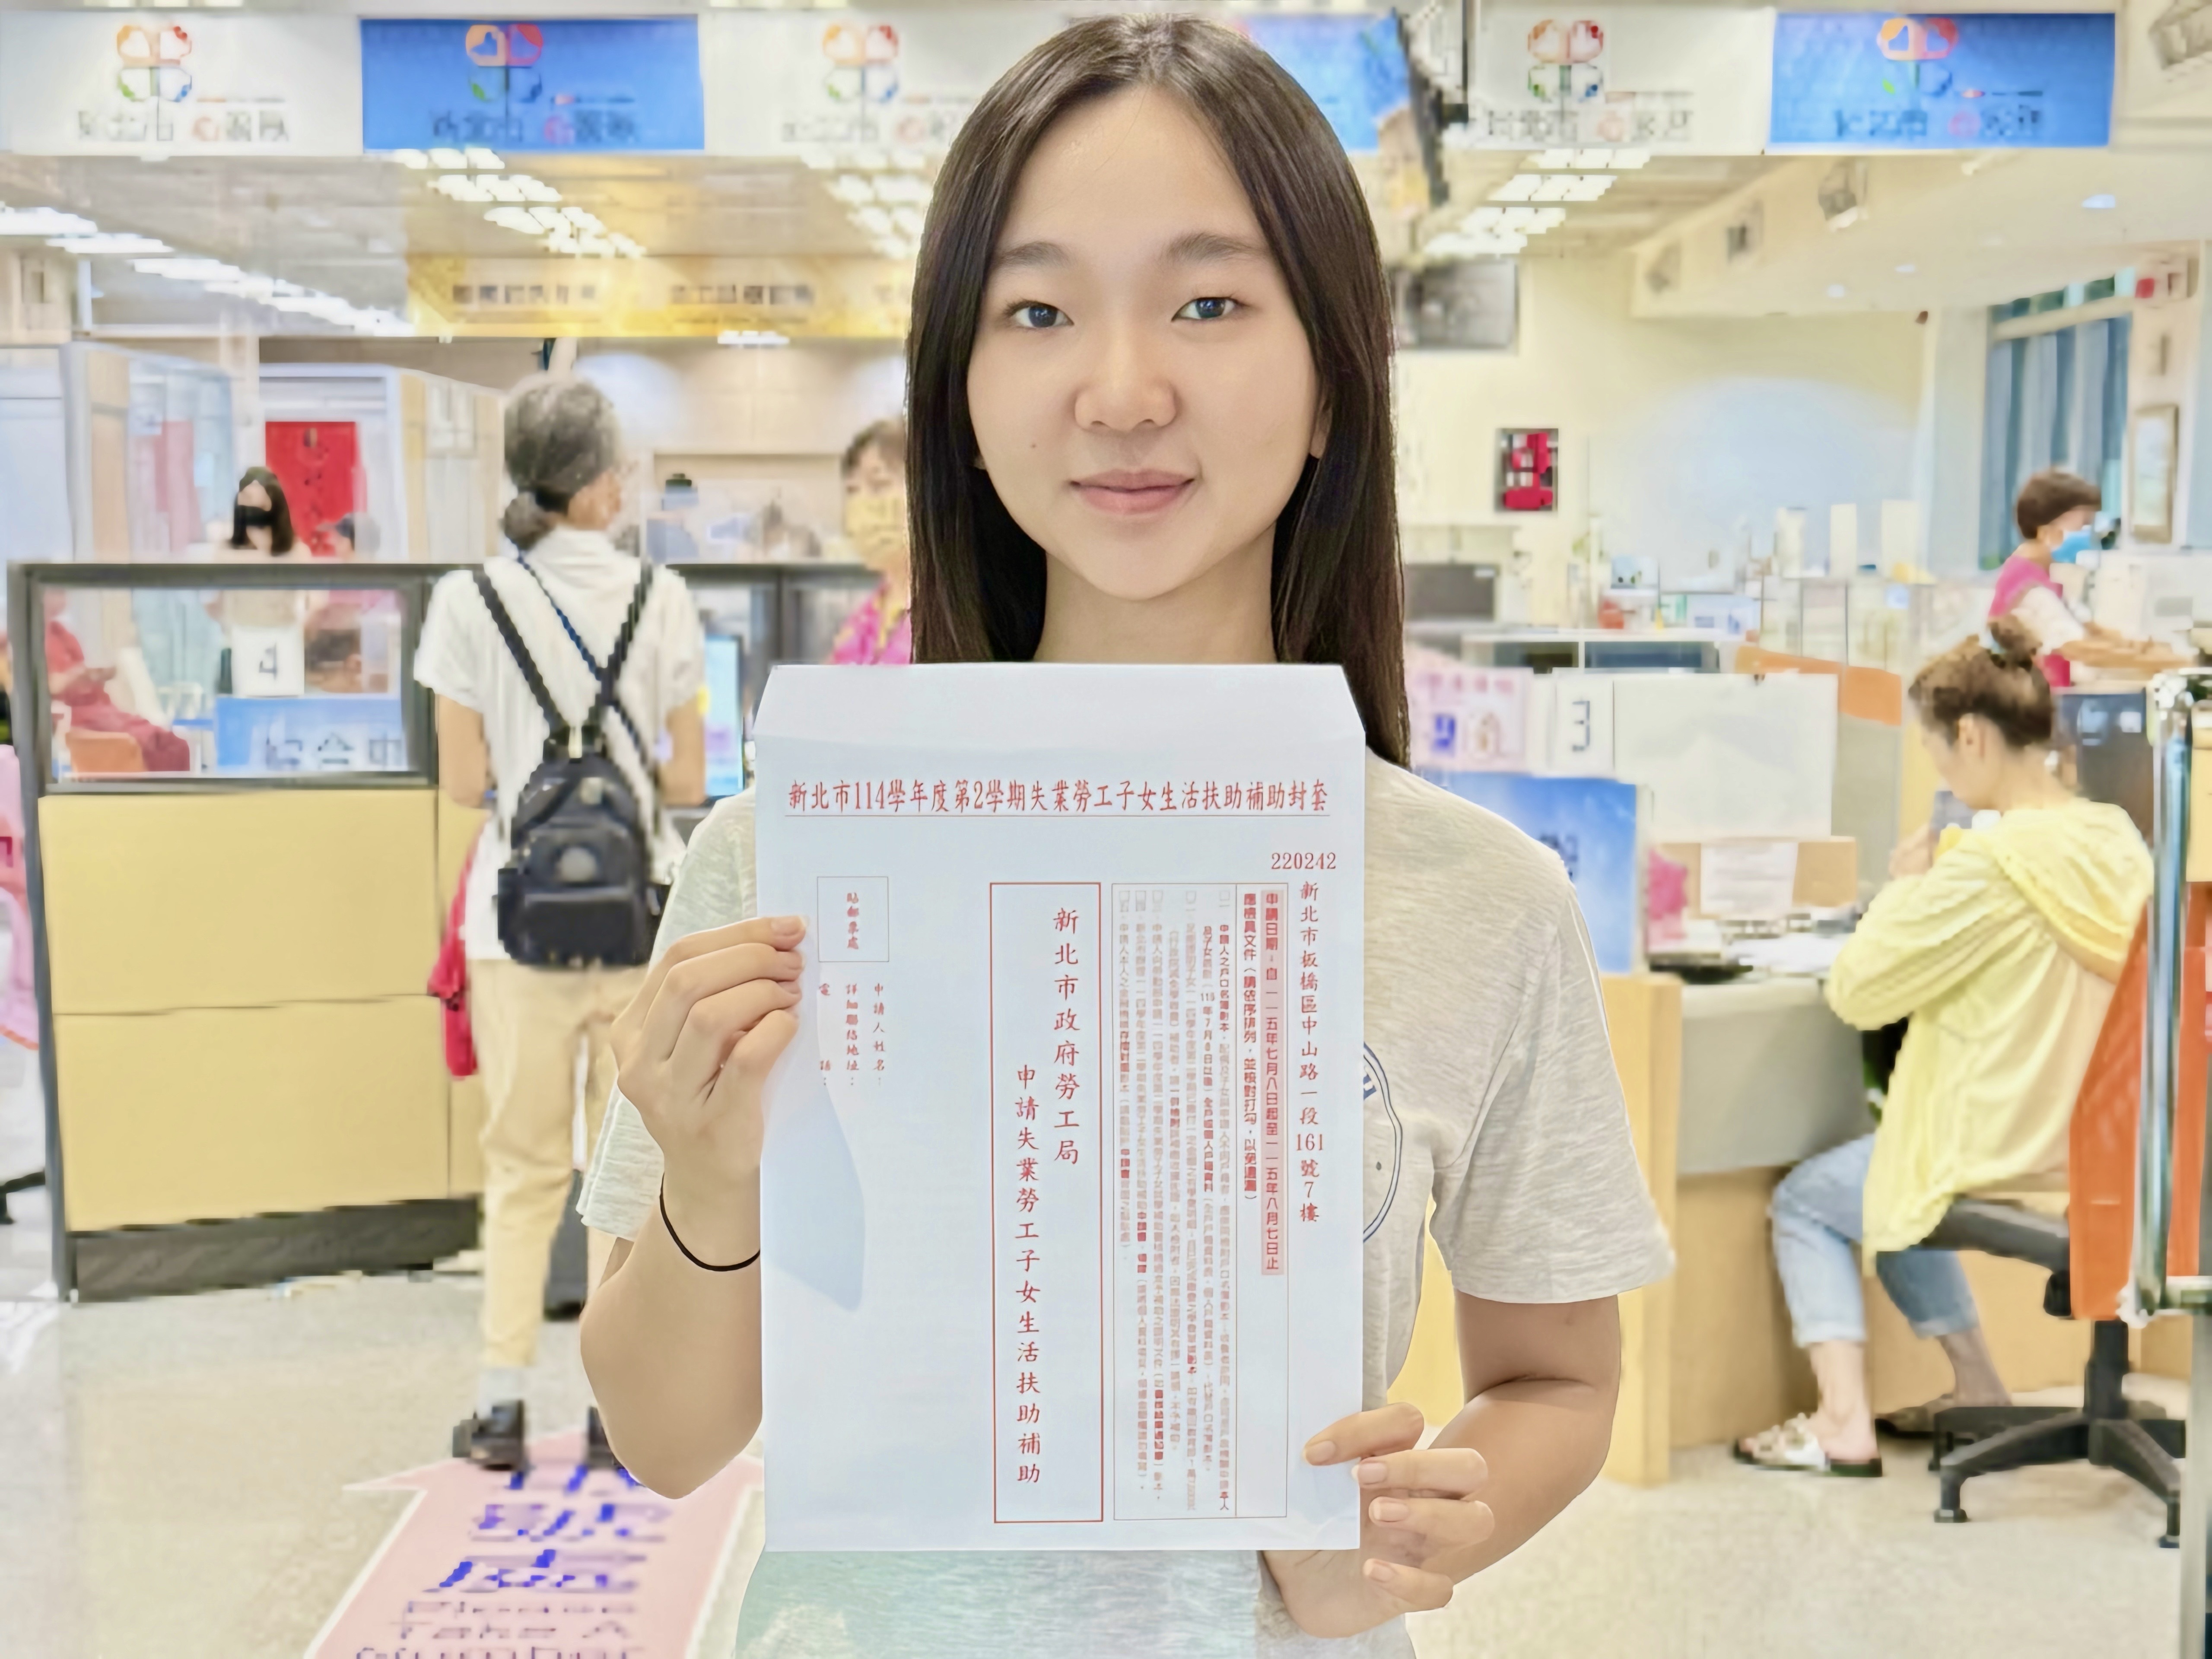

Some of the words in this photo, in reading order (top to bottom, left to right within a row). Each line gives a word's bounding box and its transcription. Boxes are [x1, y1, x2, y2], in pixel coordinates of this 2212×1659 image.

[788, 779, 1328, 813] 新北市114學年度第2學期失業勞工子女生活扶助補助封套
[1271, 852, 1336, 870] 220242
[1053, 907, 1081, 1165] 新北市政府勞工局
[1015, 1065, 1041, 1483] 申請失業勞工子女生活扶助補助
